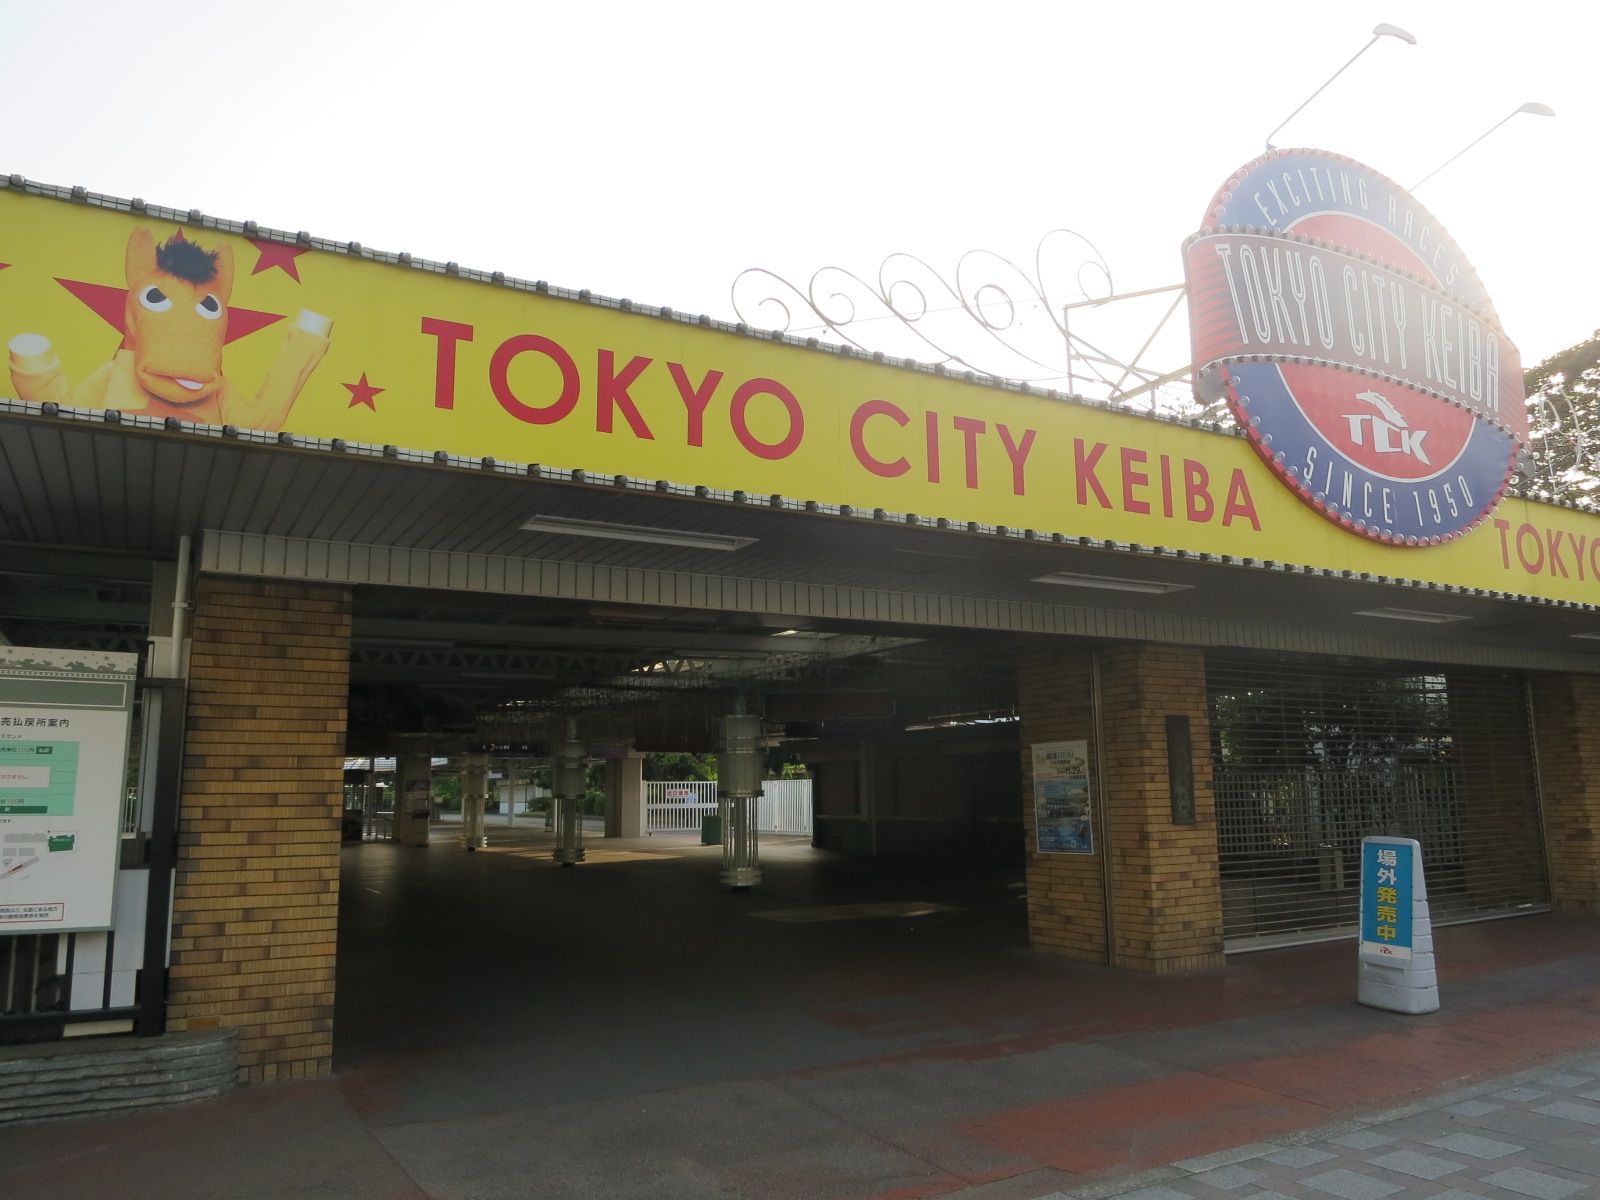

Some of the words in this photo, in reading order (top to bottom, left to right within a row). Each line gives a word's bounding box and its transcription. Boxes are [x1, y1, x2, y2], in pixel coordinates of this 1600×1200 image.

[1254, 168, 1367, 226] EXCITING
[1388, 194, 1459, 283] RACES
[1216, 243, 1333, 350] TOKYO
[1343, 265, 1407, 369] CITY
[1422, 294, 1499, 412] KEIBA
[421, 316, 804, 460] TOKYO
[850, 400, 1037, 496] CITY
[1073, 438, 1262, 531] KEIBA
[1342, 414, 1430, 466] TCK
[1304, 447, 1392, 524] SINCE
[1413, 475, 1474, 527] 1950
[1376, 849, 1397, 942] 場外発売中
